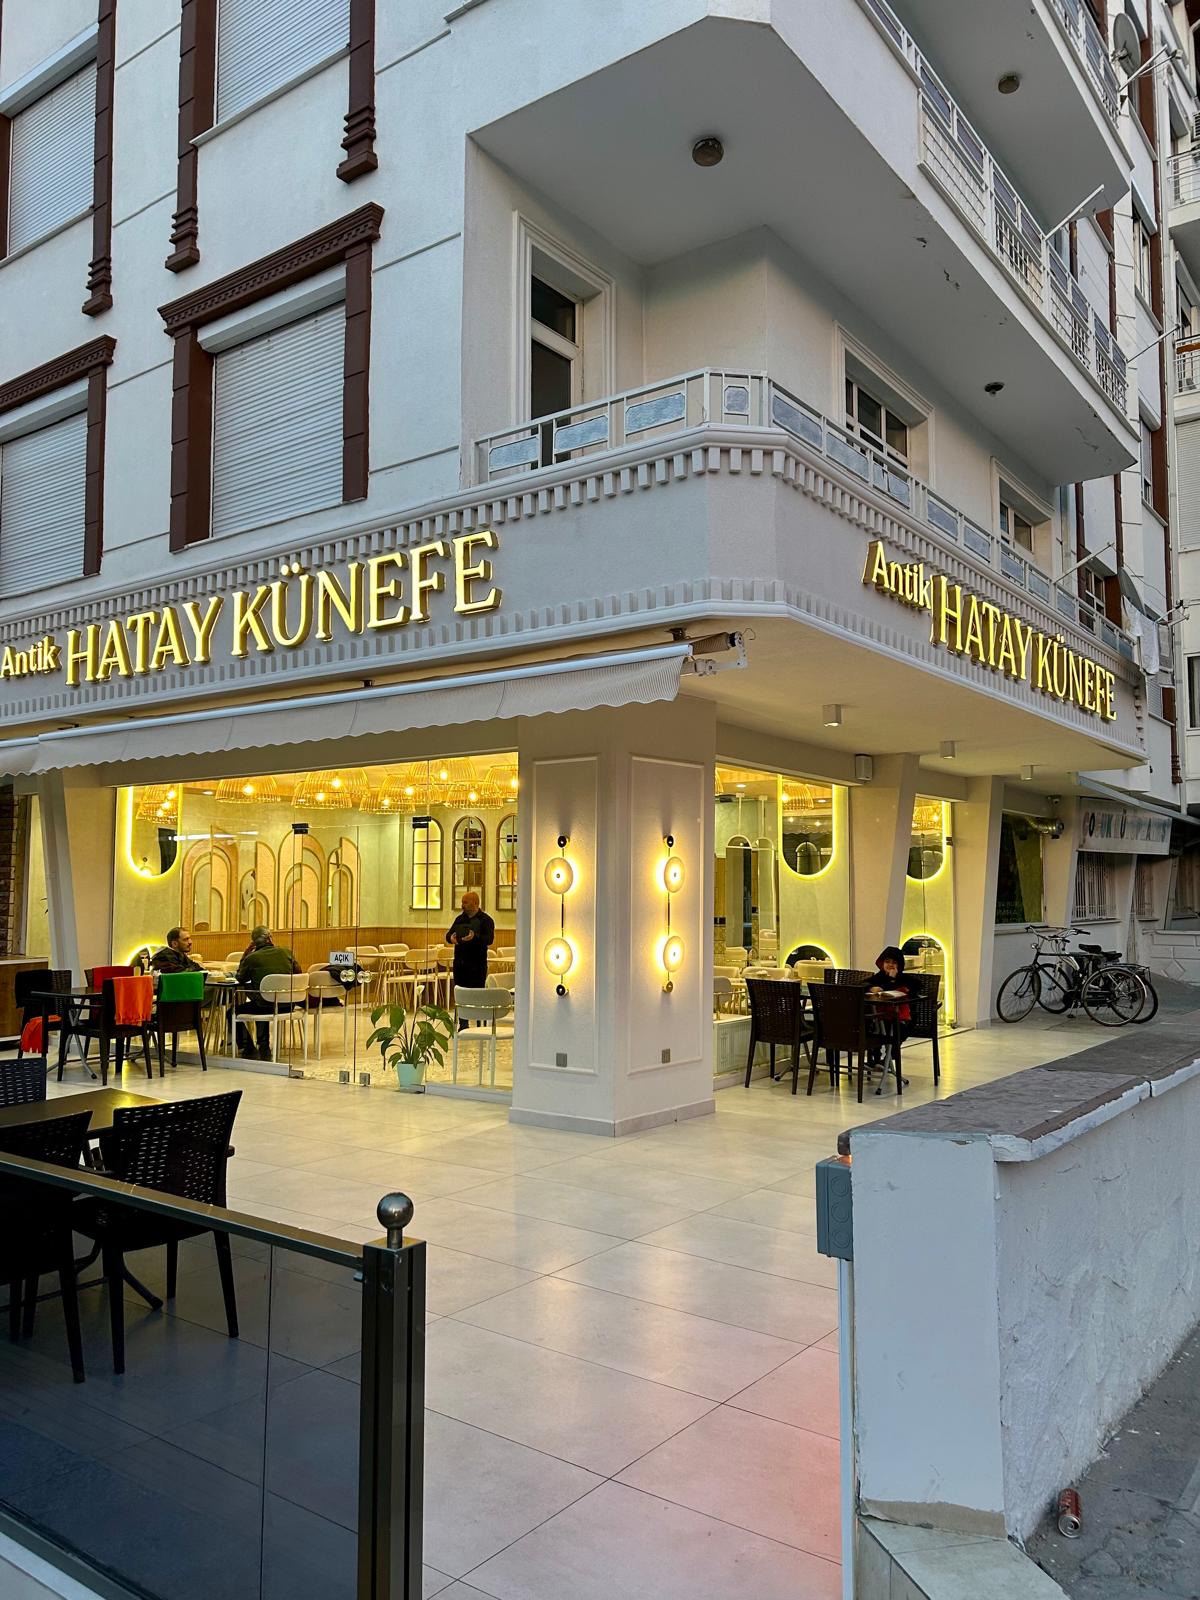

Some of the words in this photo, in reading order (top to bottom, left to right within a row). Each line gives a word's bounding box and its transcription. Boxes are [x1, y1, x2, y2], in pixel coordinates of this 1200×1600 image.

[0, 635, 61, 679] Antik
[65, 596, 224, 687] HATAY
[231, 530, 503, 658] KÜNEFE
[863, 540, 931, 610] Antik
[931, 575, 1032, 682] HATAY
[1033, 633, 1117, 721] KÜNEFE
[334, 954, 349, 963] AÇIK
